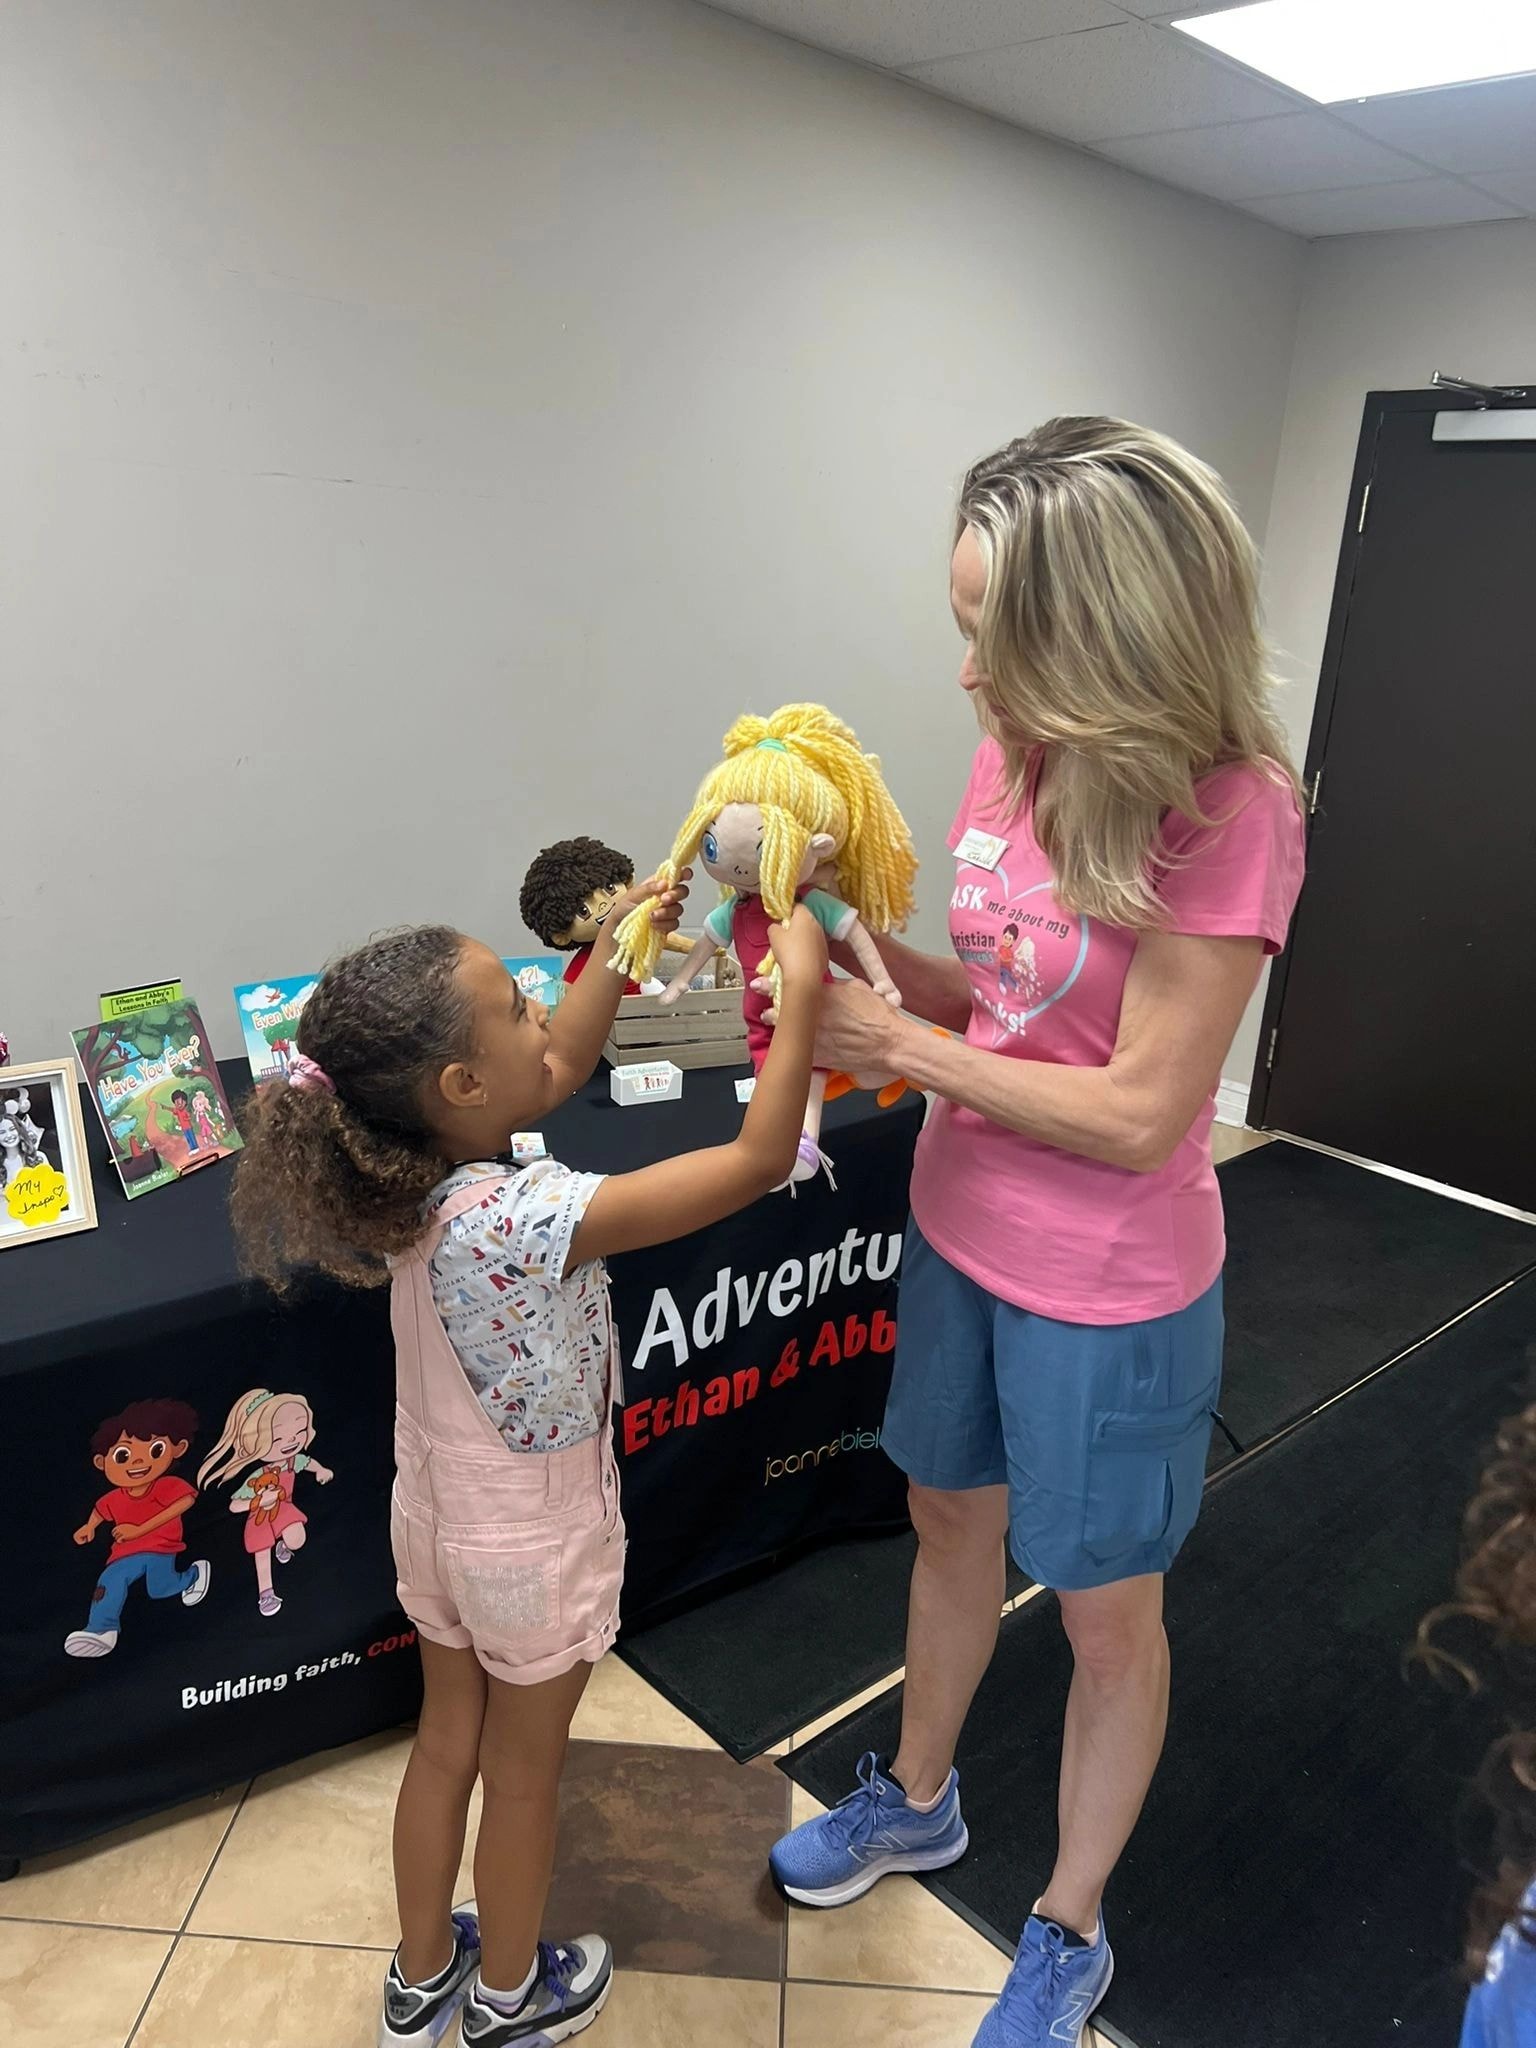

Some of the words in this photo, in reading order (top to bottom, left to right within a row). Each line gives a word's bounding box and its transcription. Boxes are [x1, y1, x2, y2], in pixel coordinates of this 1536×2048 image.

[950, 884, 987, 911] ASK
[987, 900, 1007, 916] me
[1008, 908, 1044, 928] about
[1045, 919, 1071, 939] my
[252, 1011, 282, 1030] Even
[99, 1076, 137, 1101] Have
[136, 1059, 164, 1081] You
[14, 1179, 41, 1195] My
[632, 1228, 902, 1370] Adventu
[623, 1366, 760, 1456] Ethan
[770, 1338, 801, 1388] &
[808, 1310, 896, 1366] Abb
[764, 1427, 880, 1486] joannebiel
[181, 1674, 288, 1709] Building
[295, 1651, 361, 1681] faith,
[367, 1629, 416, 1657] CON
